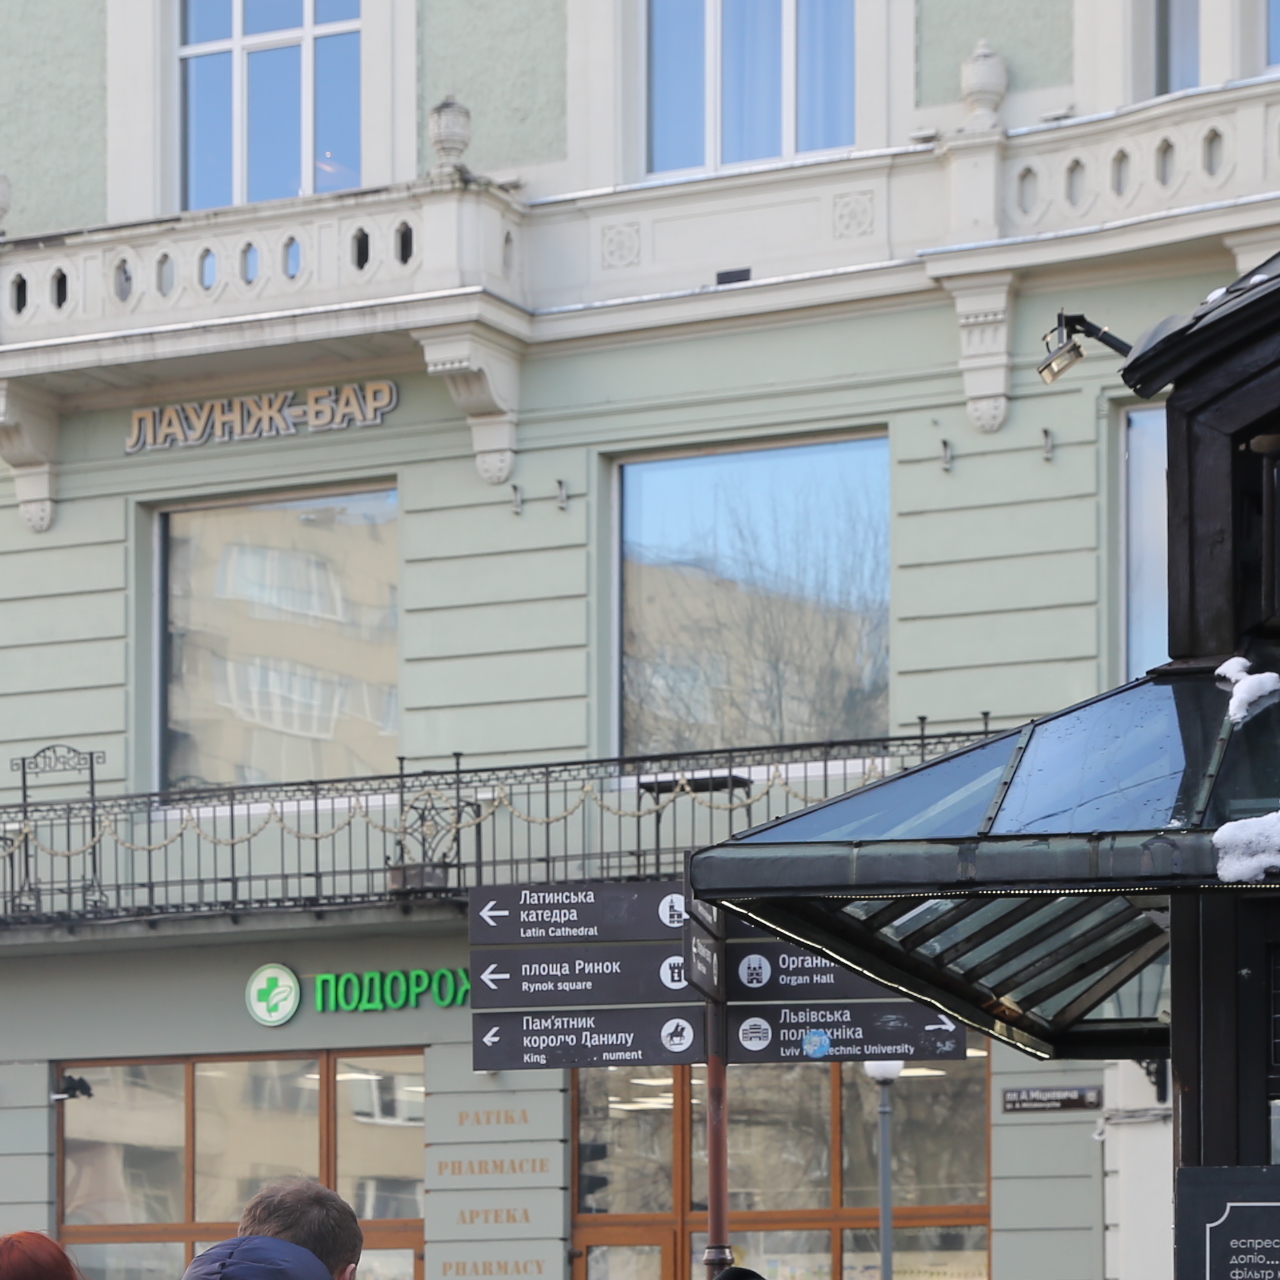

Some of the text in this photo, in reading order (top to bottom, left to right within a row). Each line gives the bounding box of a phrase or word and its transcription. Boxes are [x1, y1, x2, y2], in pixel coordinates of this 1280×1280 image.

[124, 379, 398, 454] ЛАУНЖ-БАР
[519, 889, 595, 904] Латинська
[520, 908, 578, 923] катедра
[520, 926, 598, 937] Latin Cathedral
[521, 959, 621, 977] площа Ринок
[522, 981, 593, 992] Rynok square
[779, 973, 835, 986] Organ Hall
[779, 1008, 851, 1024] Львівська
[581, 1031, 634, 1048] Данилу
[780, 1046, 801, 1057] Lviv
[864, 1044, 915, 1056] University
[523, 1053, 547, 1065] King
[458, 1109, 529, 1126] PATIKA
[437, 1158, 550, 1176] PHARMACIE
[456, 1208, 531, 1225] APTEKA
[1229, 1253, 1266, 1264] допіо
[441, 1260, 546, 1277] PHARMACY
[1230, 1267, 1274, 1280] фільтр
